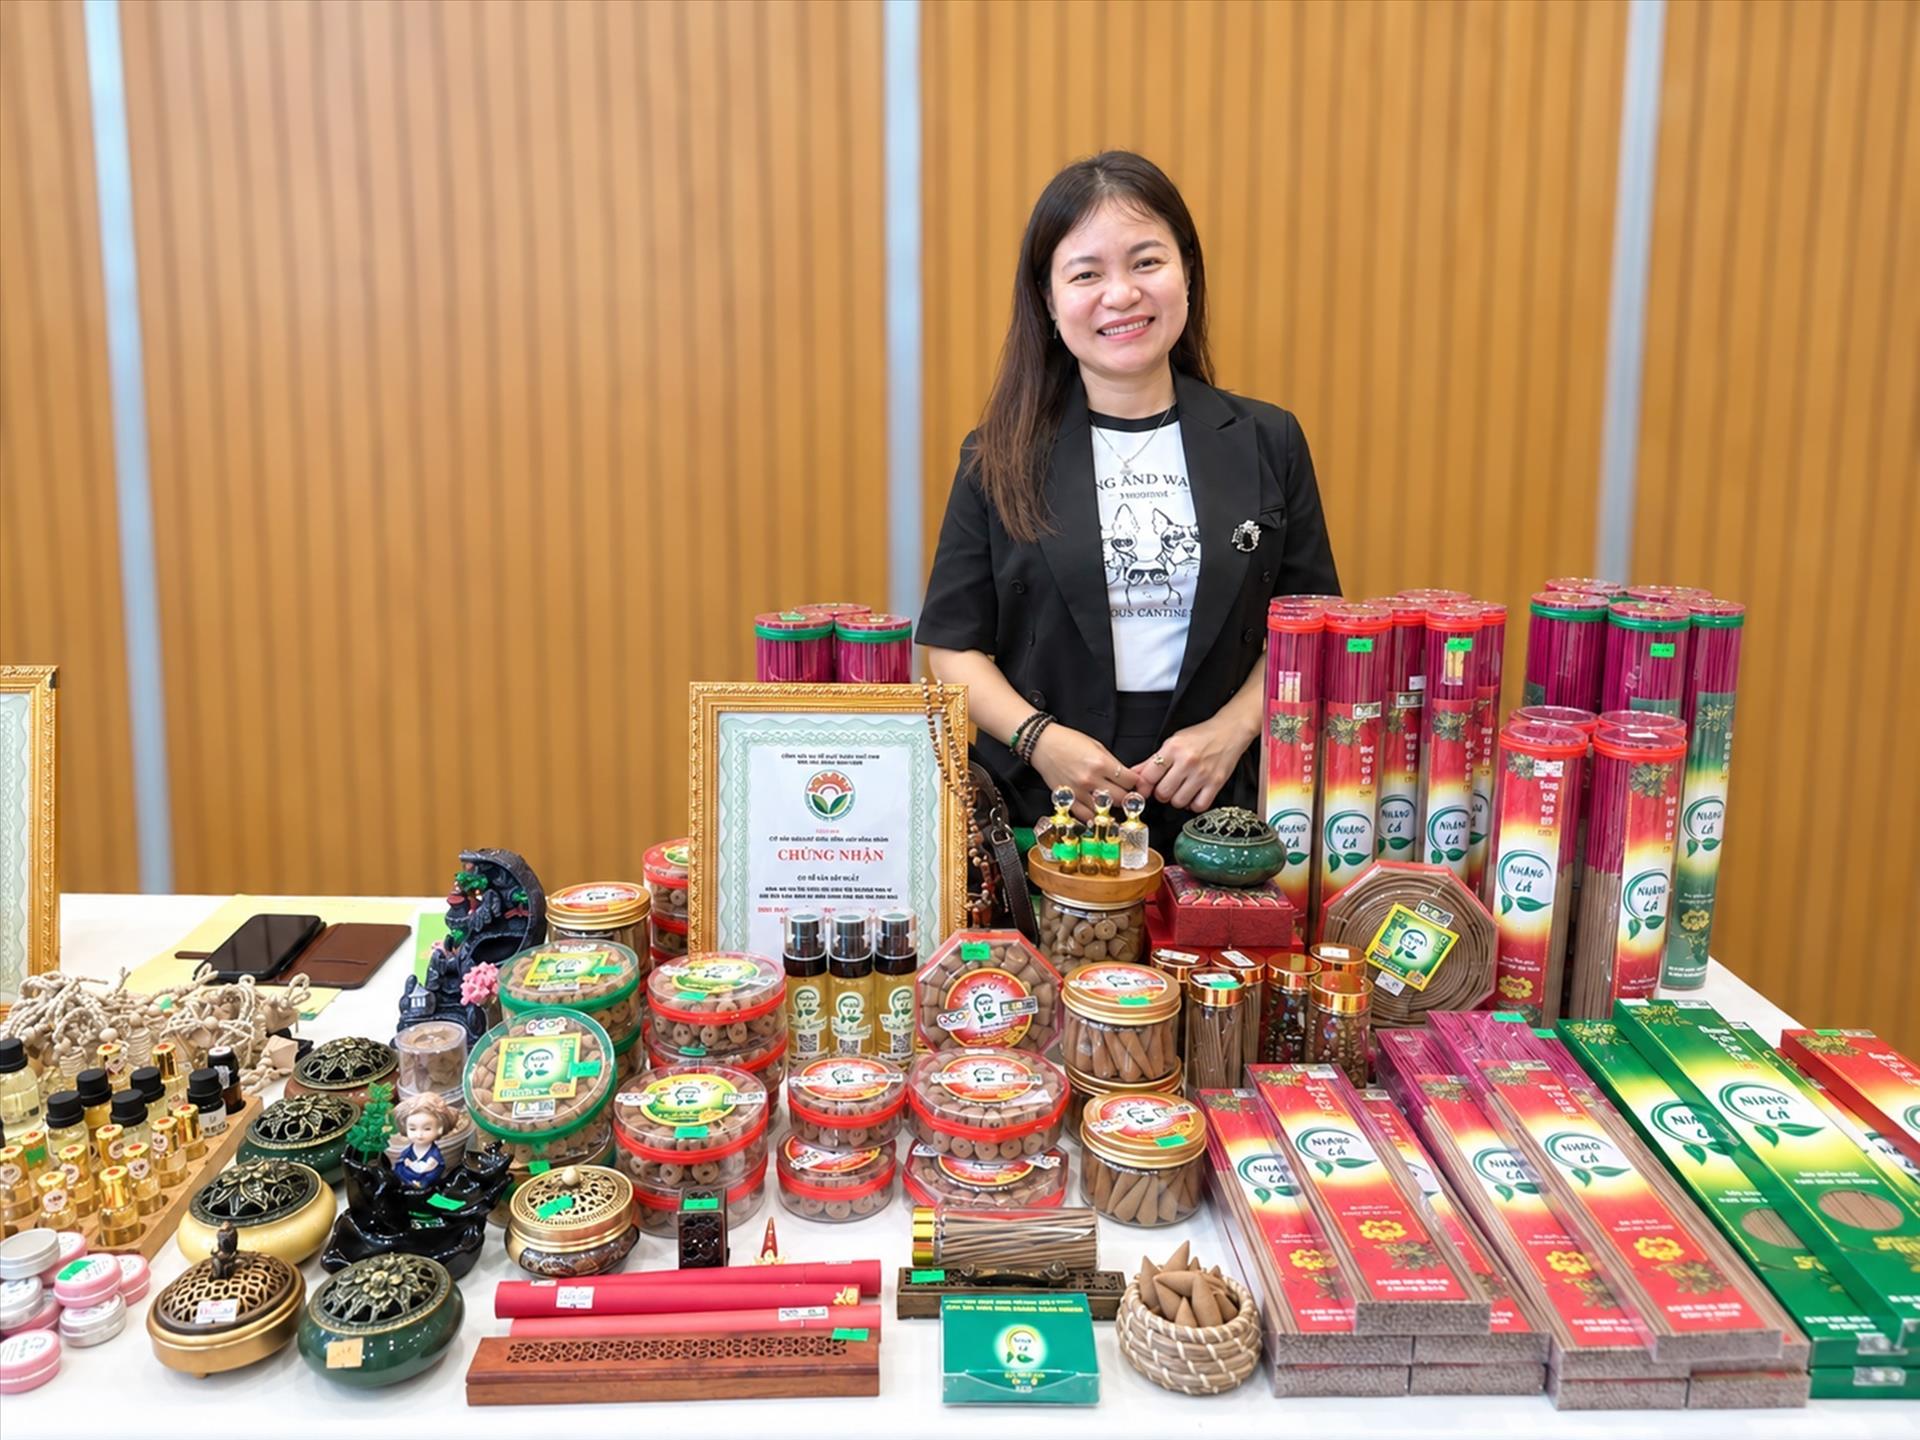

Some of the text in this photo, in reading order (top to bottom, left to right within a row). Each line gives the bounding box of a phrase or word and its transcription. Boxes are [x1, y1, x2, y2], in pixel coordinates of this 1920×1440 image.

[1121, 473, 1159, 486] AND
[1137, 608, 1188, 618] CANTINE
[778, 846, 884, 864] CHỨNG NHẬN
[1509, 865, 1544, 878] NHANG
